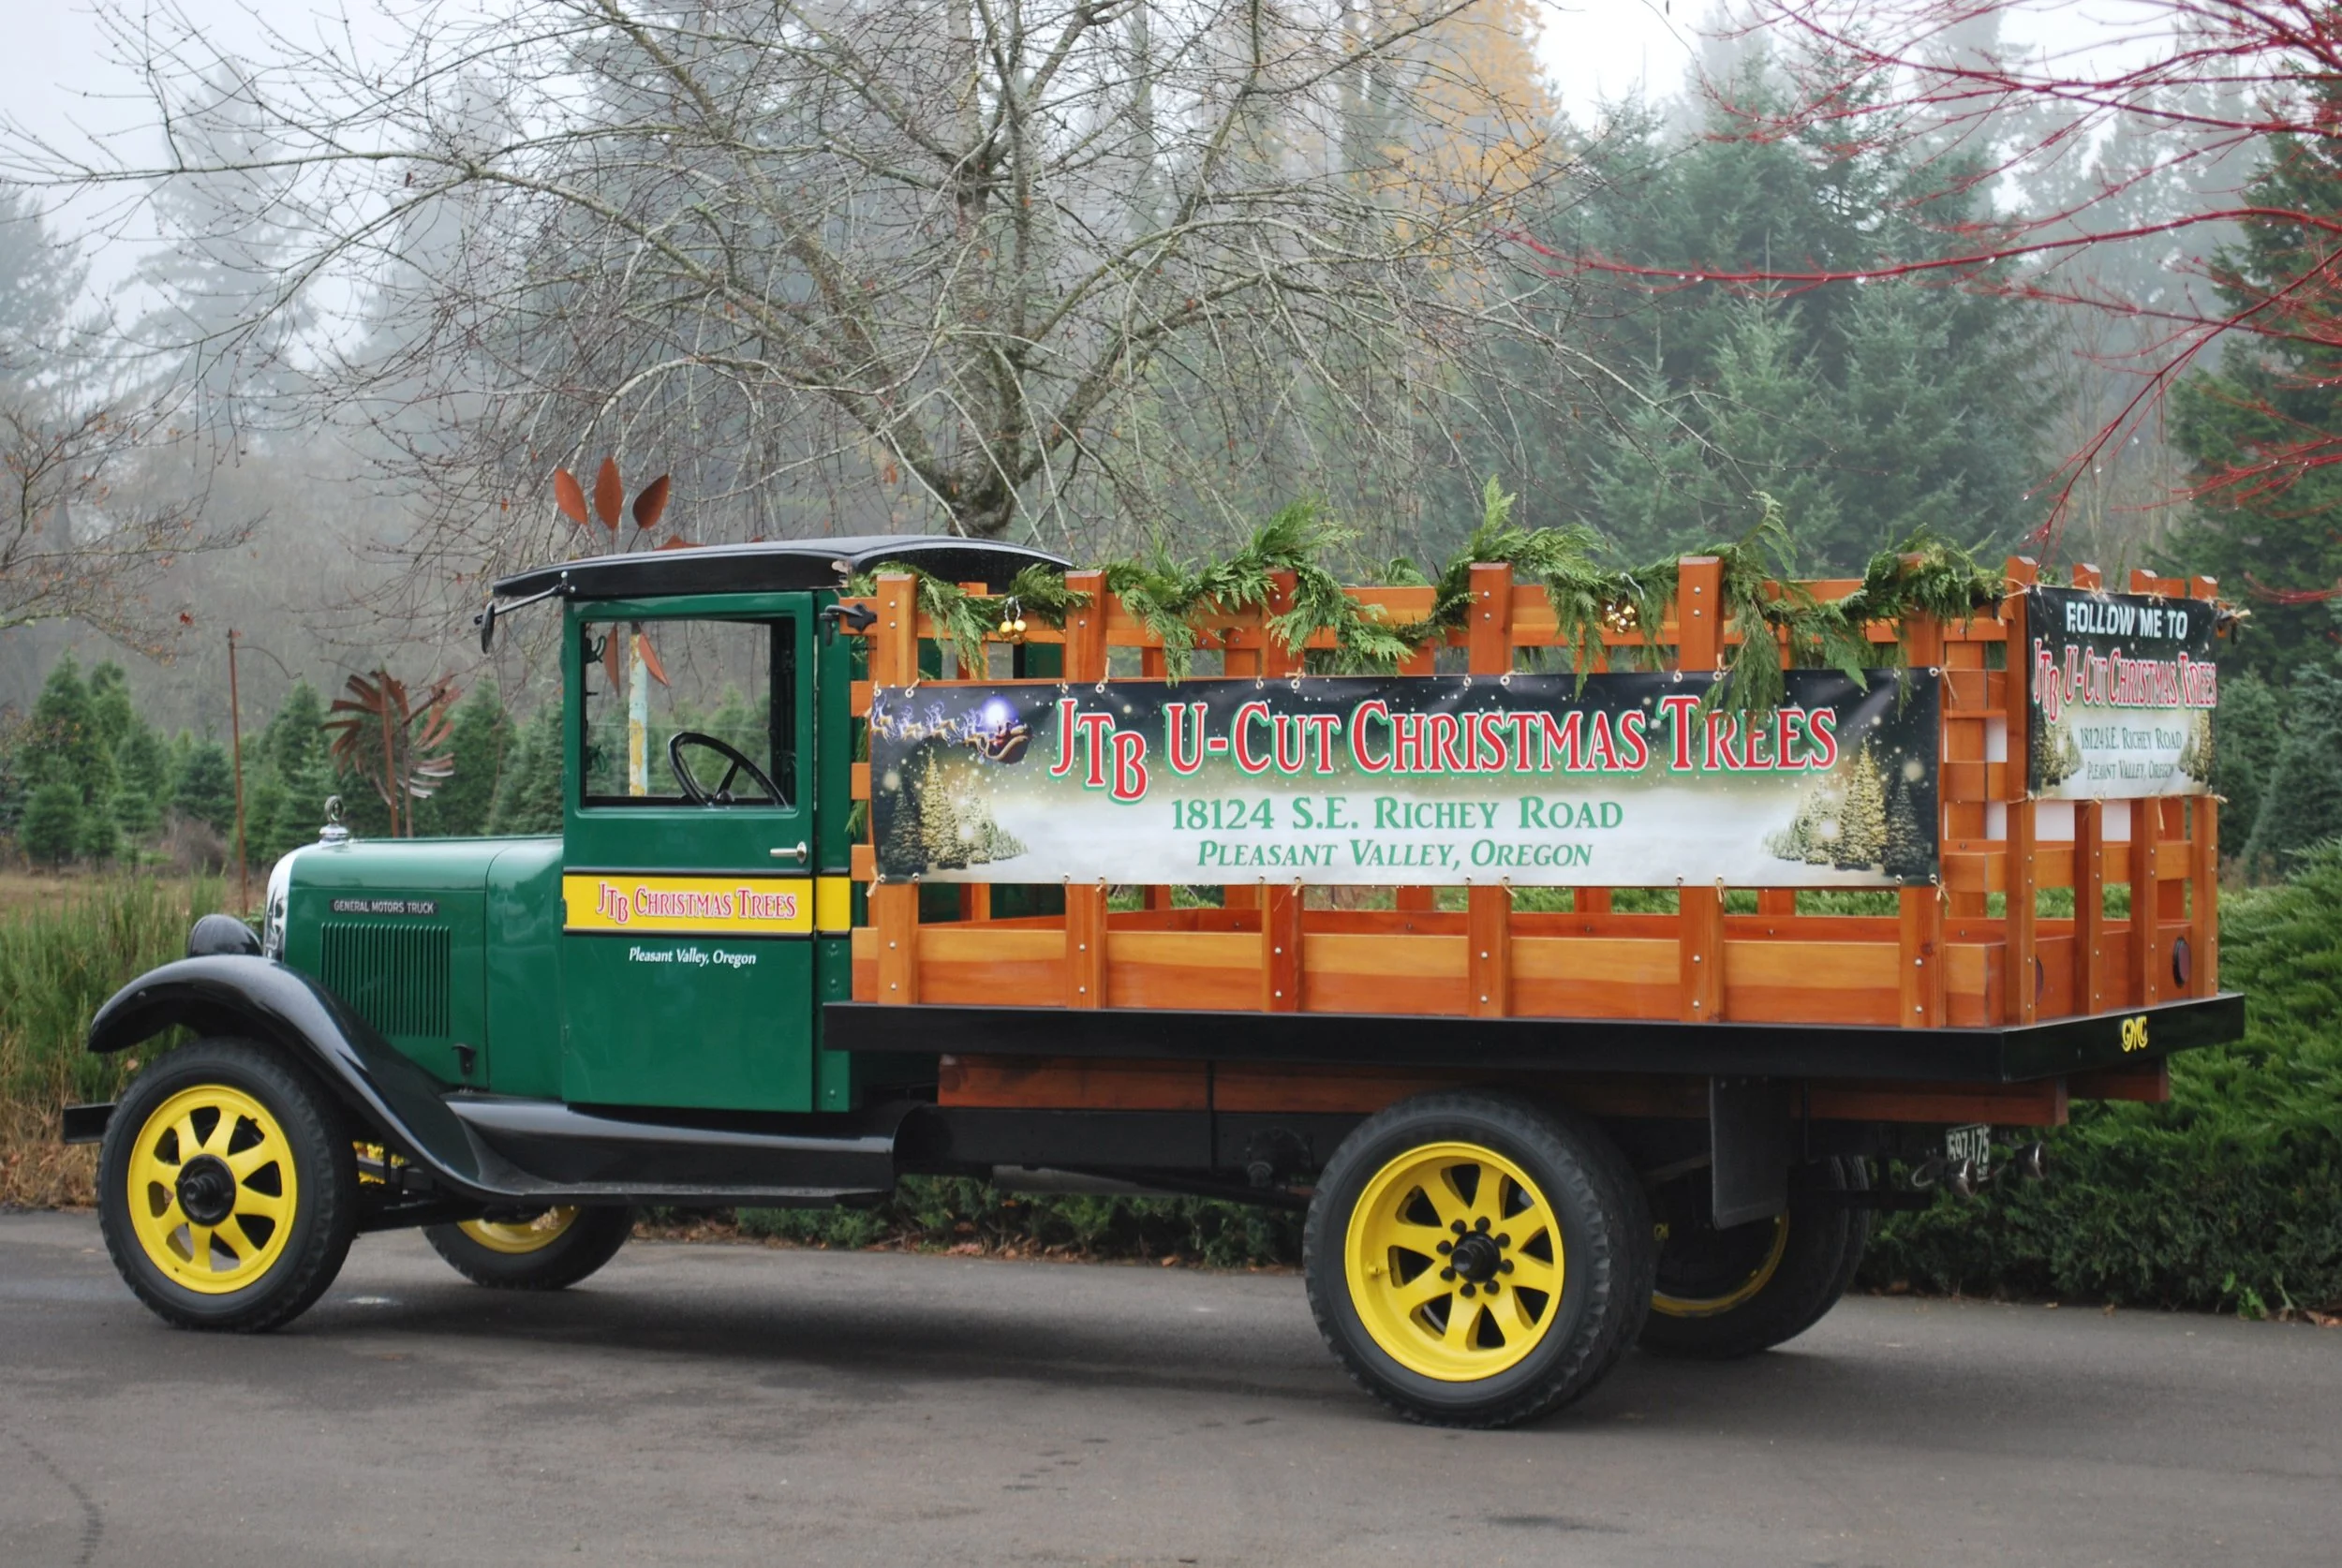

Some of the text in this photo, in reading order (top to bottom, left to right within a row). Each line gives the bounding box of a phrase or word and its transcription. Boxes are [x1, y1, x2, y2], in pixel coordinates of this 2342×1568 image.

[2066, 601, 2188, 640] FOLLOW ME TO
[2109, 647, 2179, 708] CHRISTMAS
[1048, 694, 1840, 804] JTB U-CUT CHRISTMAS TREES
[2122, 727, 2152, 750] RICHEY
[2155, 727, 2183, 749] ROAD
[1171, 795, 1623, 830] 18124 S.E. RICHEY ROAD
[1196, 838, 1593, 871] PLEASANT VALLEY, OREGON
[334, 899, 435, 915] GENERAL MOTORS TRUCK
[596, 881, 796, 925] JTB CHRISTMAS TREES
[629, 946, 757, 969] Pleasant Valley, Oregon
[2121, 1015, 2148, 1052] GMC
